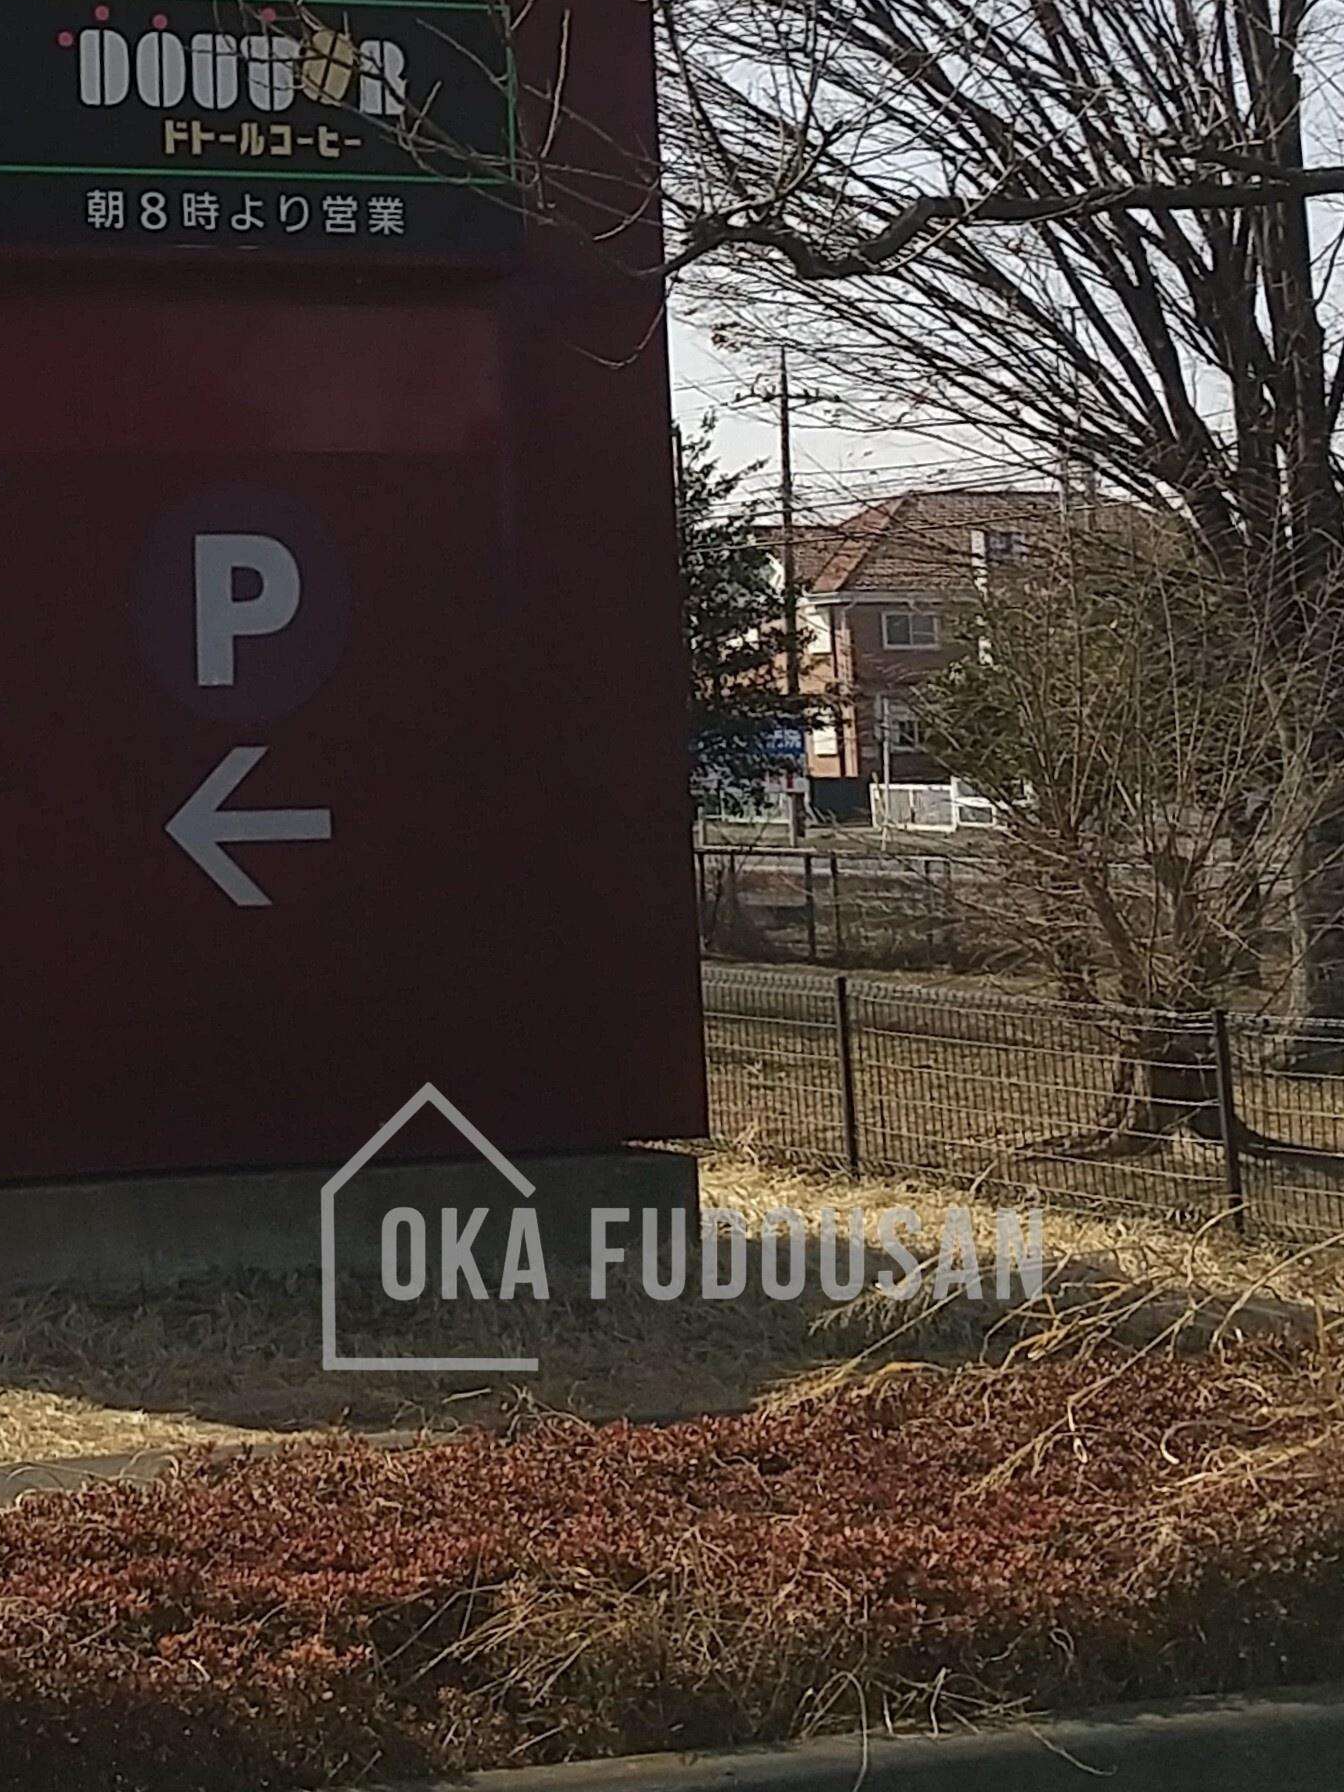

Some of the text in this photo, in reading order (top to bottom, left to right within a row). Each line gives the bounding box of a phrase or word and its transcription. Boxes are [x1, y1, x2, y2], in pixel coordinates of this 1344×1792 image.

[163, 119, 363, 159] ドトールコーヒー
[194, 533, 301, 687] P
